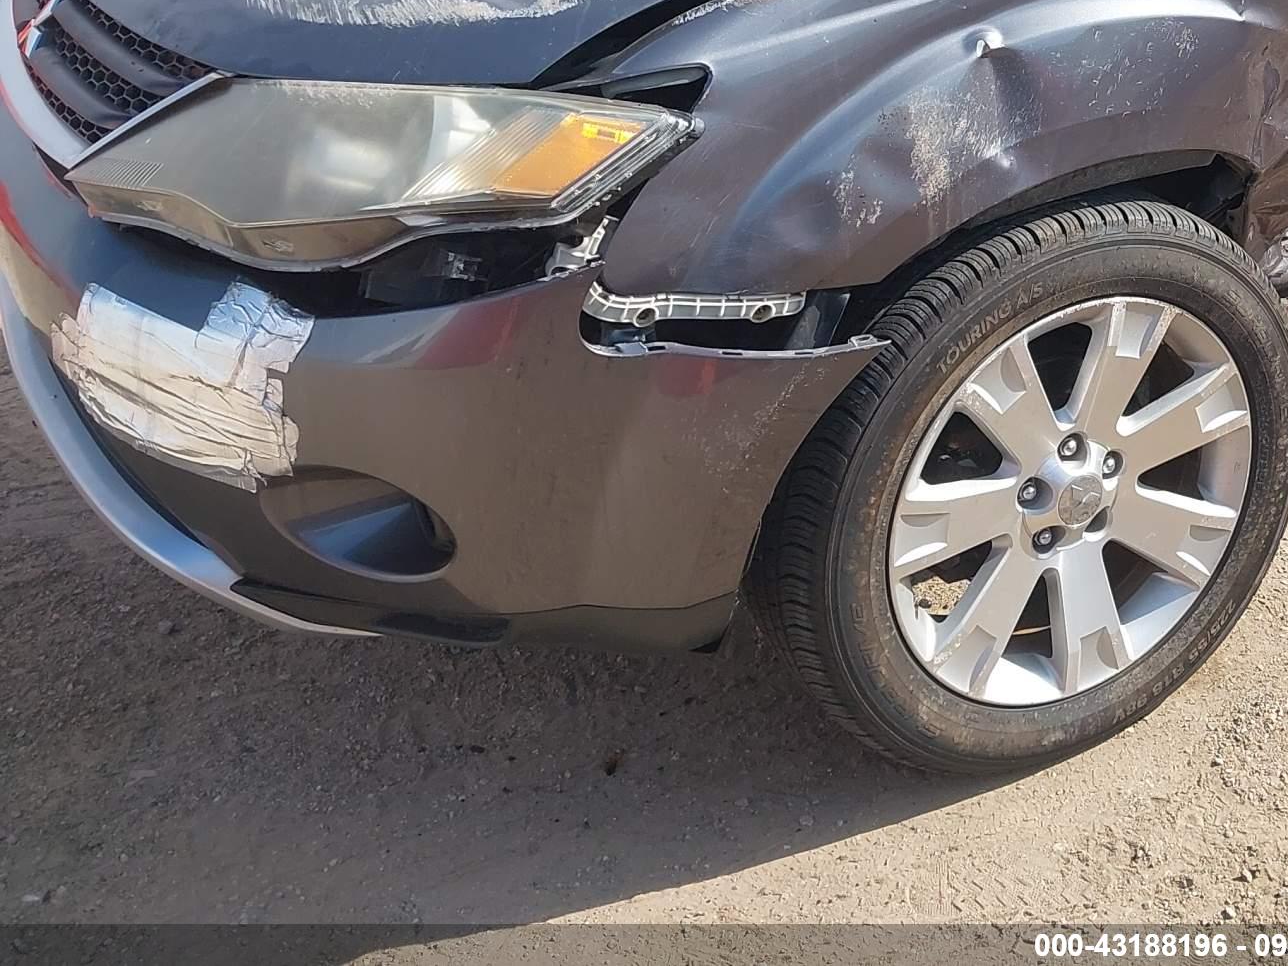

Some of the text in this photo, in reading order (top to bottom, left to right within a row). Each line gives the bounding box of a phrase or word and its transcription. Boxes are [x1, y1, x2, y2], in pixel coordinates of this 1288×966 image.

[936, 281, 1043, 374] TOURING A/S
[1187, 599, 1237, 662] 225/55
[1151, 665, 1185, 696] R18
